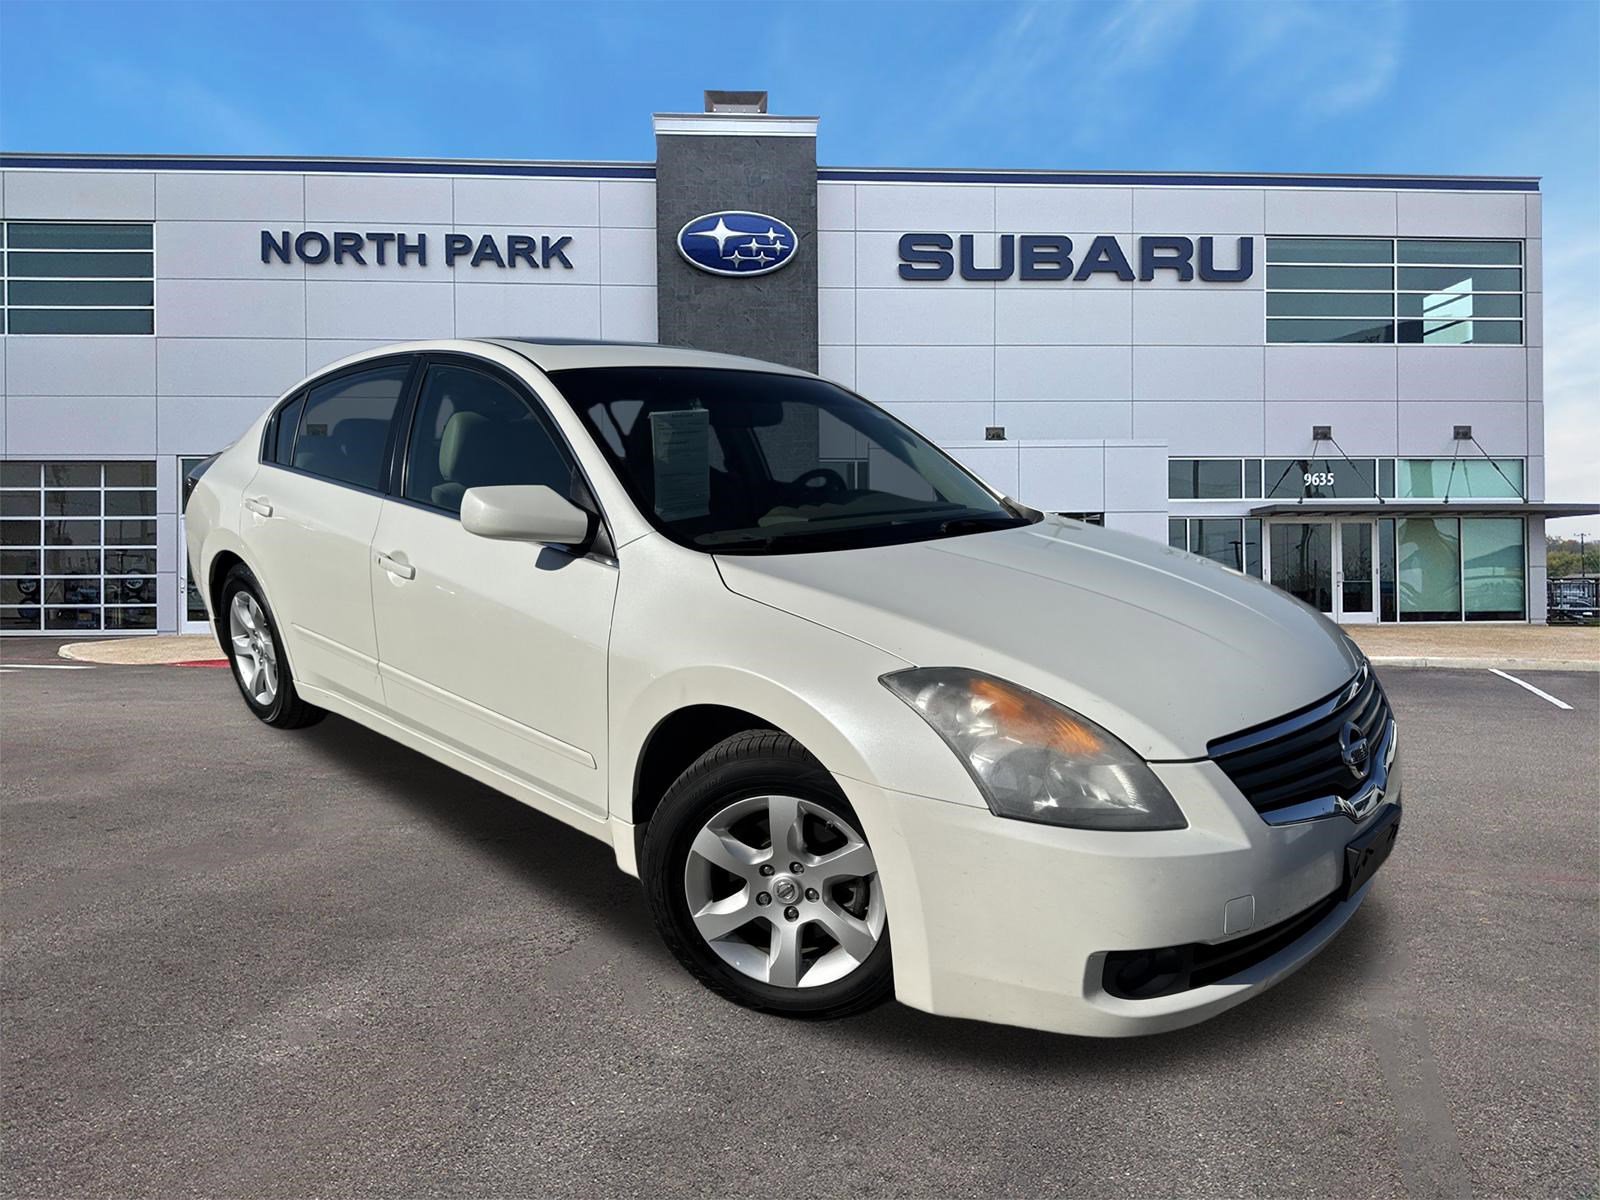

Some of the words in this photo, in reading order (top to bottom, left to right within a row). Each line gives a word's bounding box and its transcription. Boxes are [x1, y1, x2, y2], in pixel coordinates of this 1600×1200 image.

[260, 230, 427, 266] NORTH
[444, 233, 574, 269] PARK
[898, 232, 1254, 282] SUBARU
[1303, 472, 1335, 486] 9635
